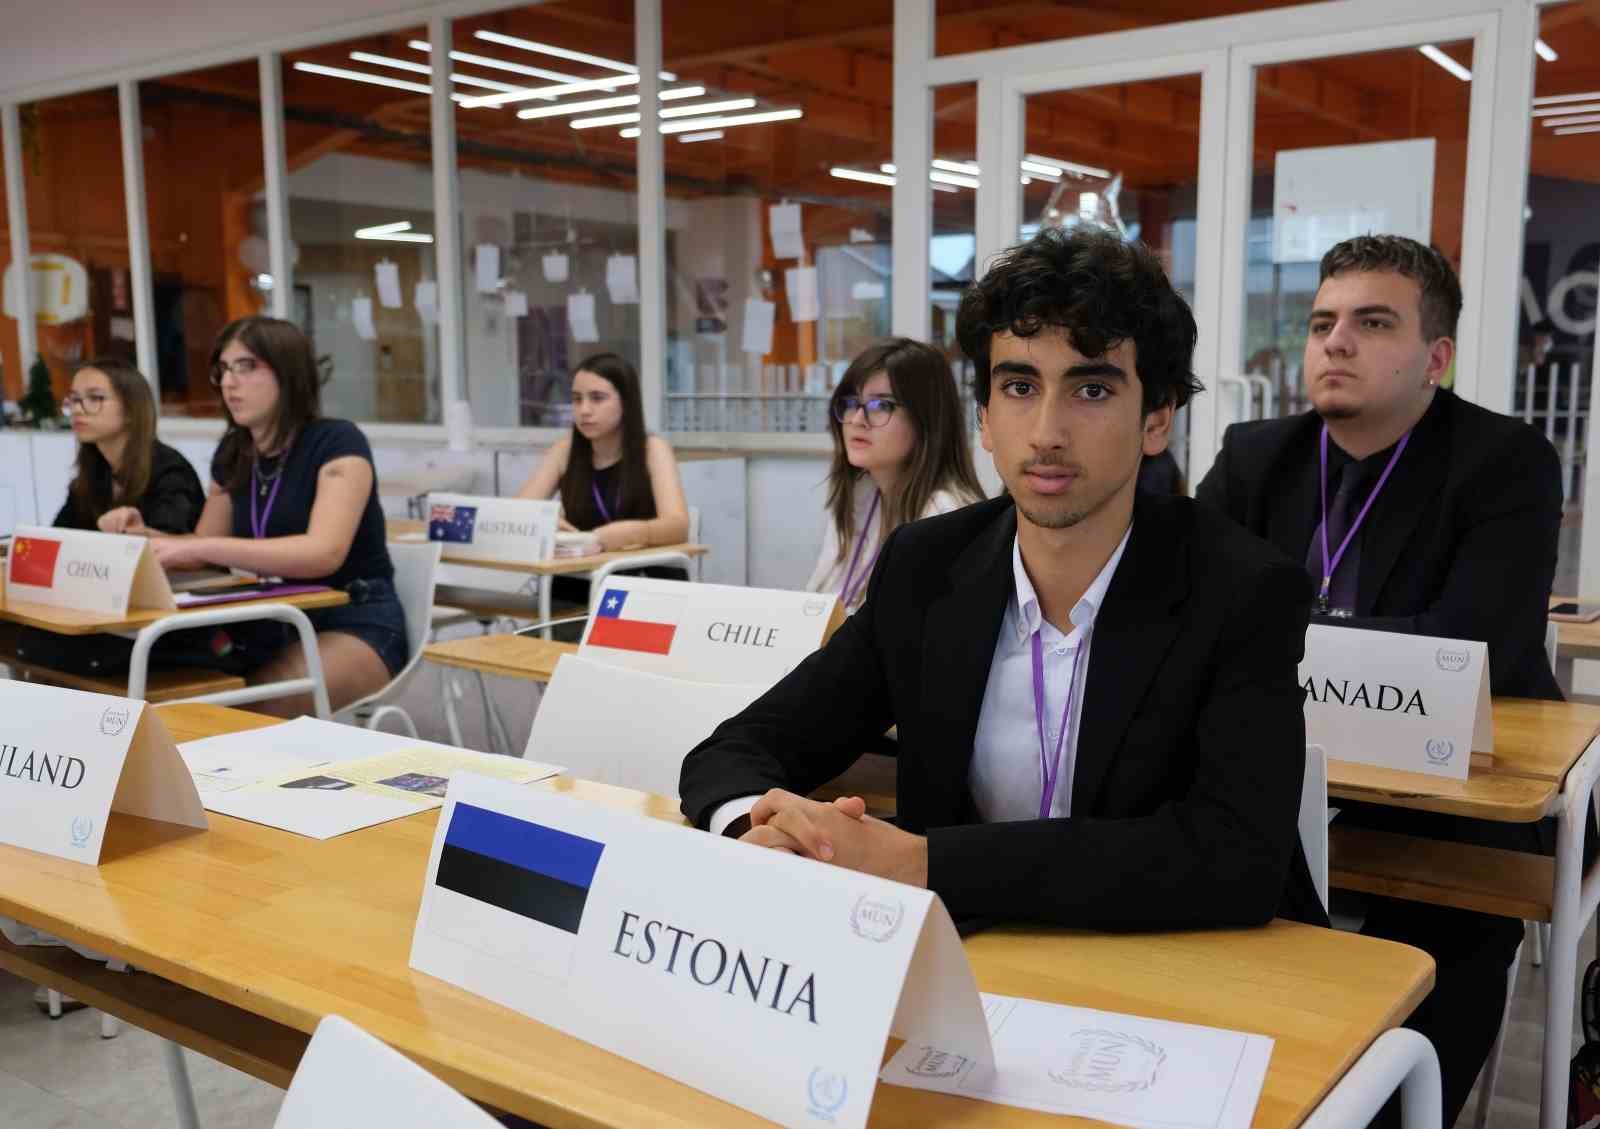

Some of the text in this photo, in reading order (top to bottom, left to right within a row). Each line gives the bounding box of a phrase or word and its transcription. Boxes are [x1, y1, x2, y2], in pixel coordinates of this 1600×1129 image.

[66, 559, 110, 581] CHINA
[707, 621, 780, 648] CHILE
[859, 907, 895, 926] MUN
[613, 911, 819, 1025] ESTONIA
